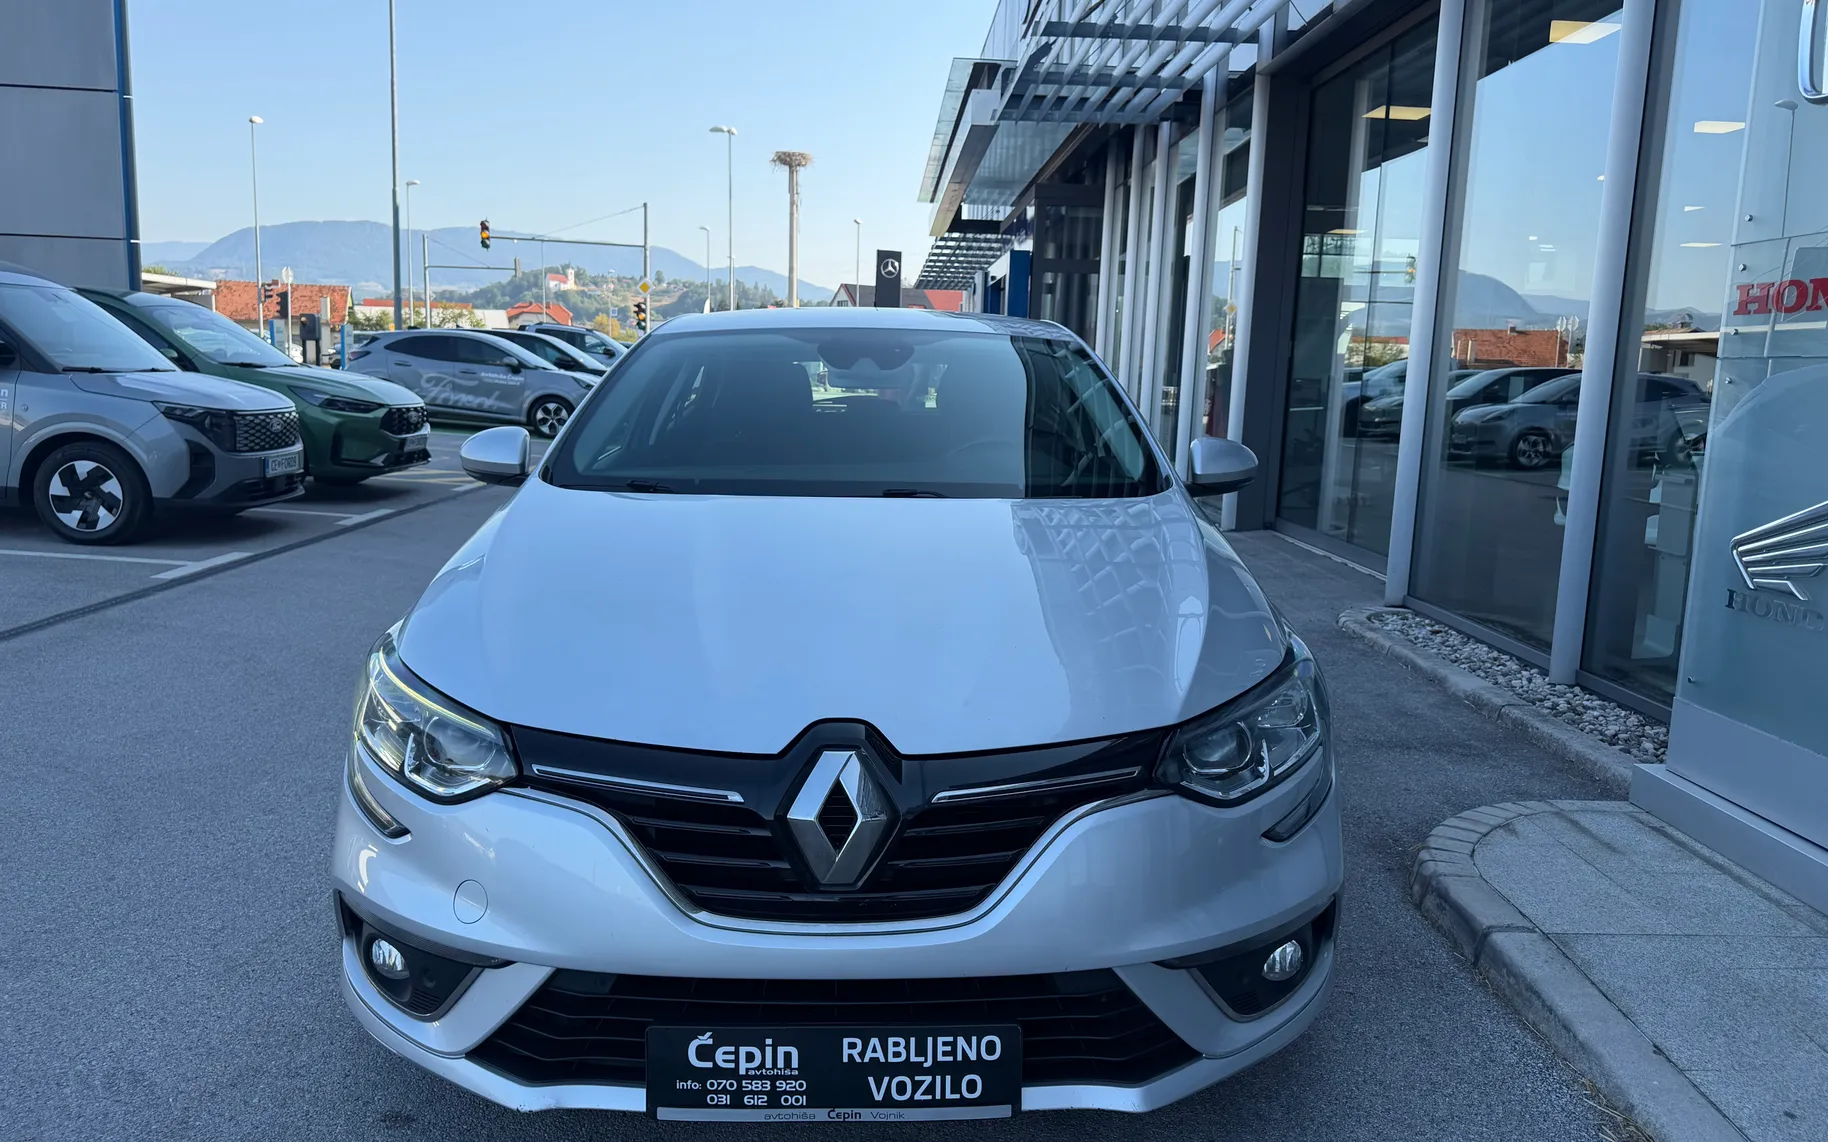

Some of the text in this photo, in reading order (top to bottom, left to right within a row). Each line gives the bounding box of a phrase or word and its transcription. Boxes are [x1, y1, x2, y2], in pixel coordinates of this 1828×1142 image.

[688, 1031, 799, 1076] Čepin
[842, 1035, 1002, 1068] RABLJENO
[747, 1068, 799, 1077] avtohiša
[676, 1079, 807, 1092] info: 070 583 920
[867, 1074, 983, 1102] VOZILO
[706, 1093, 807, 1107] 031 612 001
[763, 1111, 817, 1121] avtohiša
[870, 1111, 905, 1121] Vojnik
